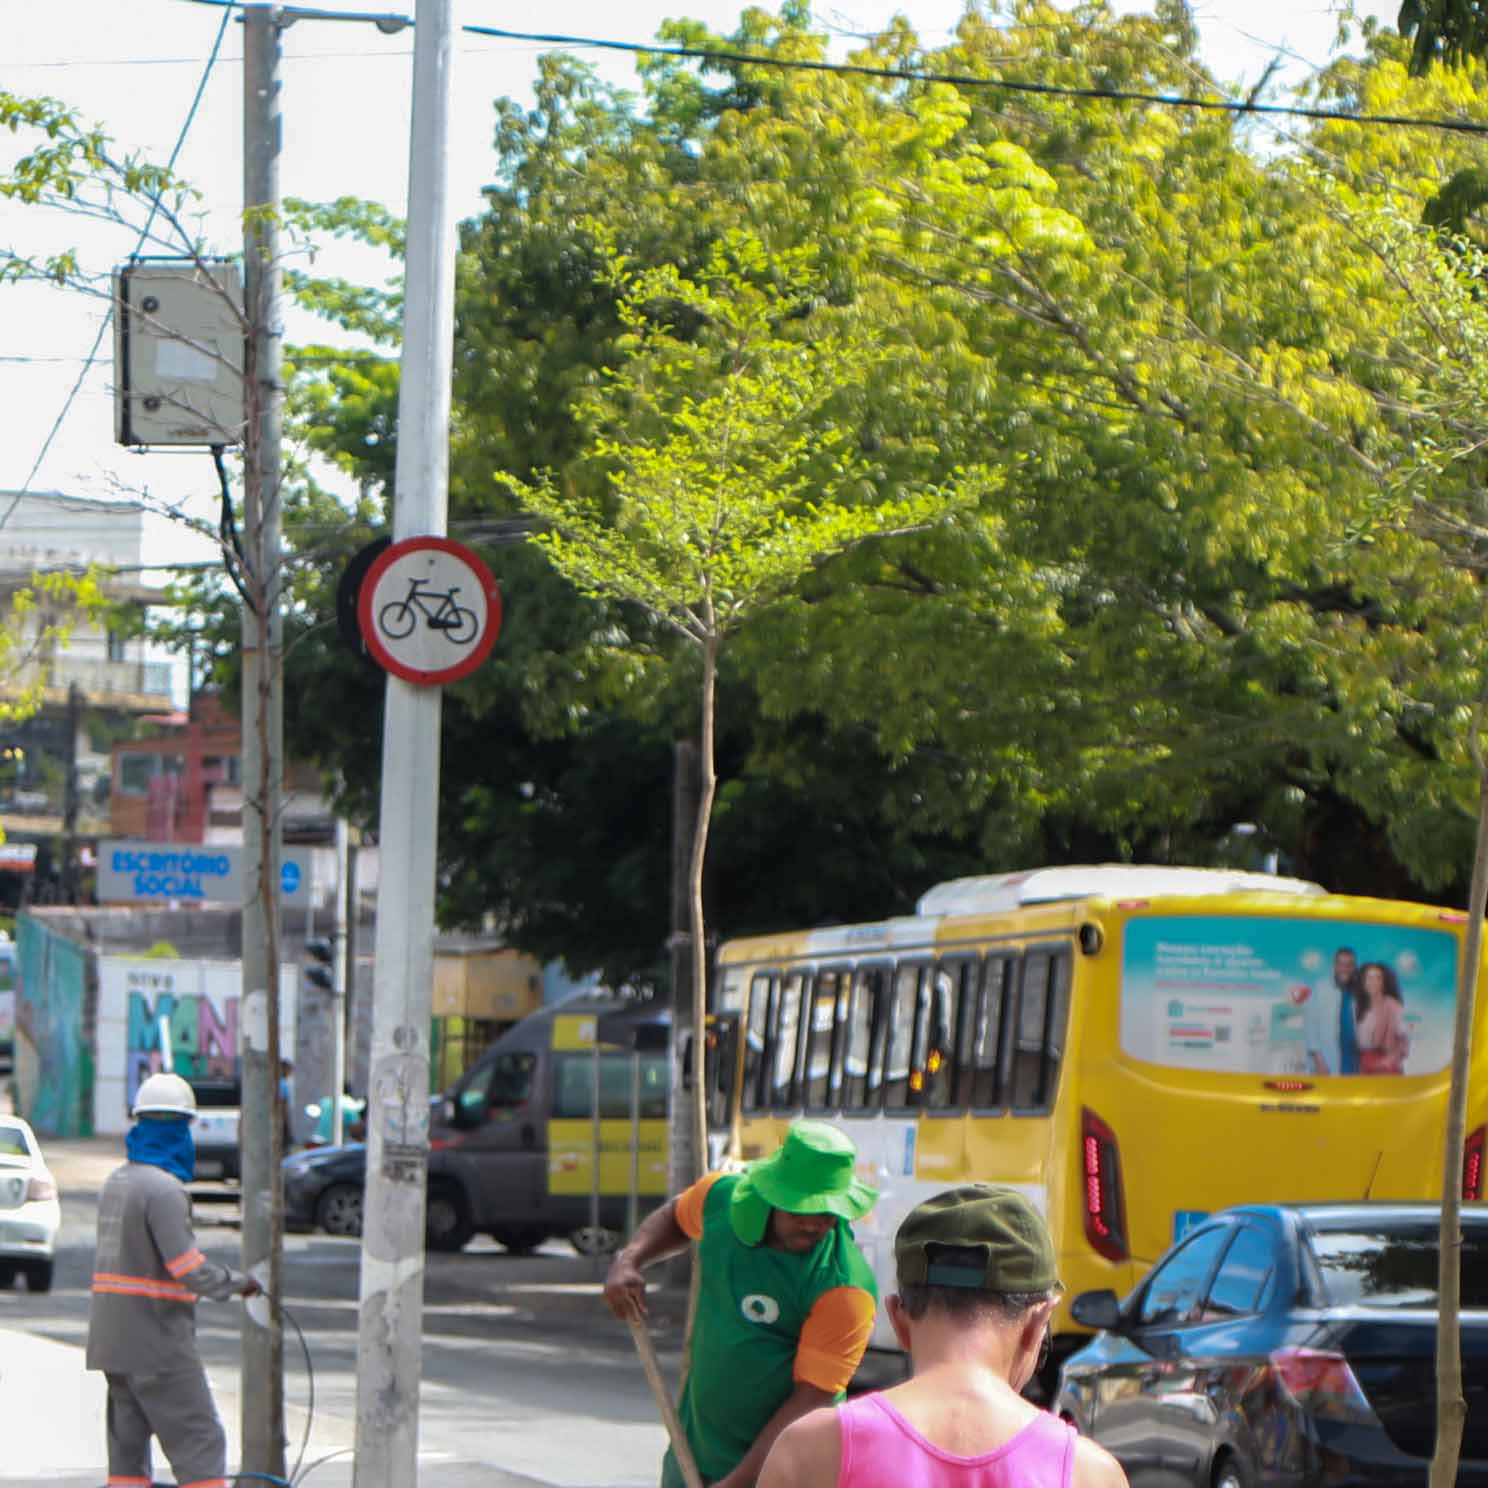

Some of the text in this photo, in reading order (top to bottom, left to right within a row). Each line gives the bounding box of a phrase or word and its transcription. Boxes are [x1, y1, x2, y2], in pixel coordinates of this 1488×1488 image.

[112, 849, 230, 876] ESCRITÓRIO
[133, 873, 205, 897] SOCIAL
[128, 990, 240, 1056] MAN
